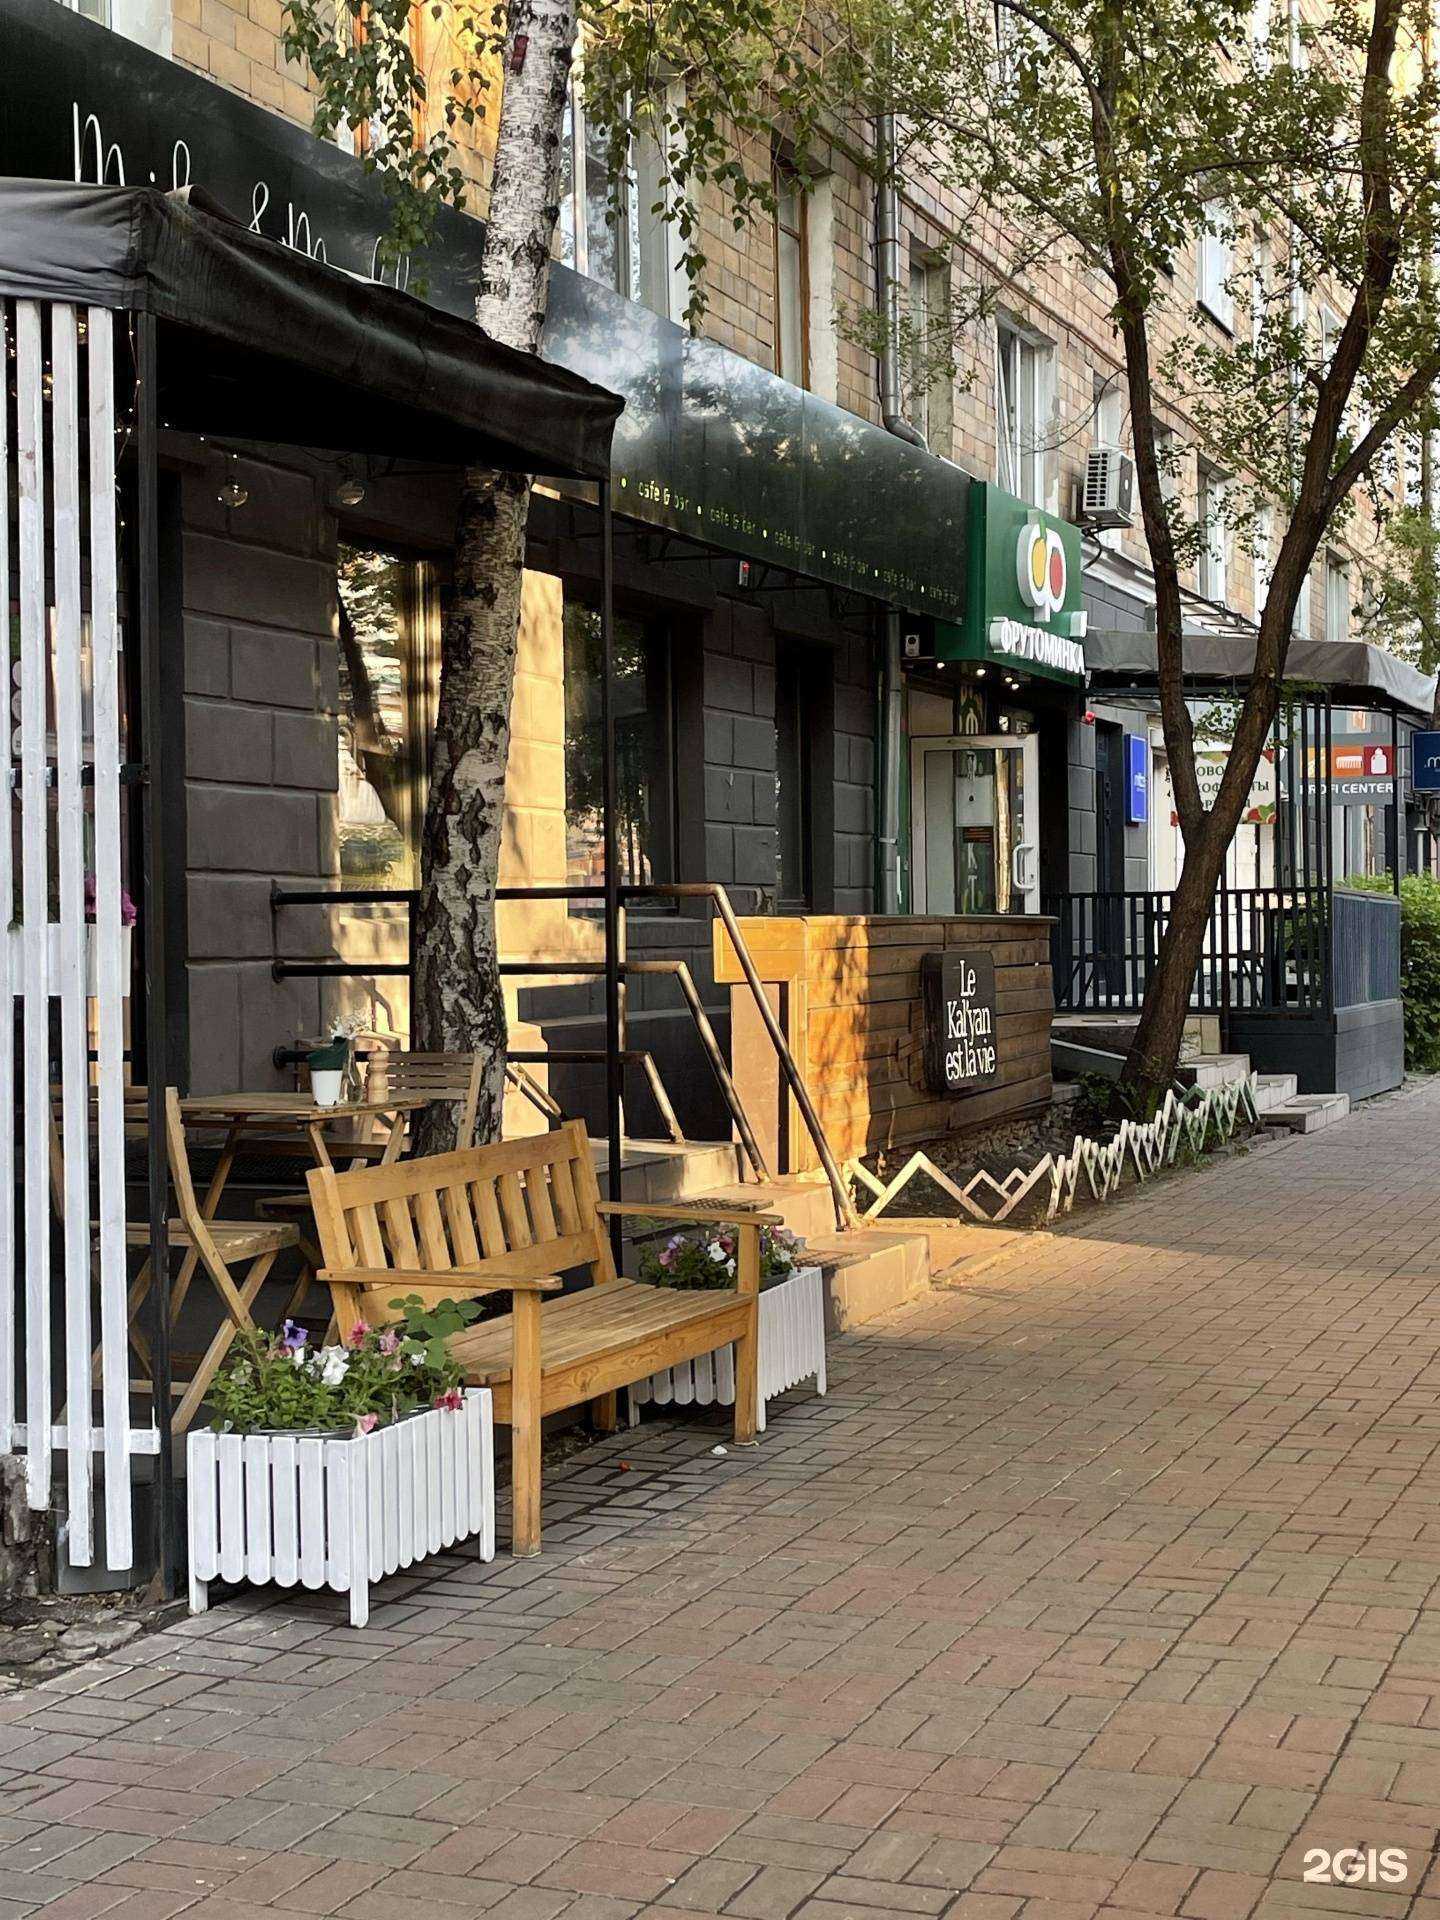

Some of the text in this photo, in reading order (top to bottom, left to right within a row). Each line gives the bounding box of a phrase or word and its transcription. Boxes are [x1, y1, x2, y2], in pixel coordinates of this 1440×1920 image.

[638, 480, 660, 502] cafe
[999, 618, 1086, 676] ФРУТОМИНКА
[1341, 782, 1394, 795] CENTER
[959, 959, 977, 997] Le
[945, 1037, 996, 1081] est la vie
